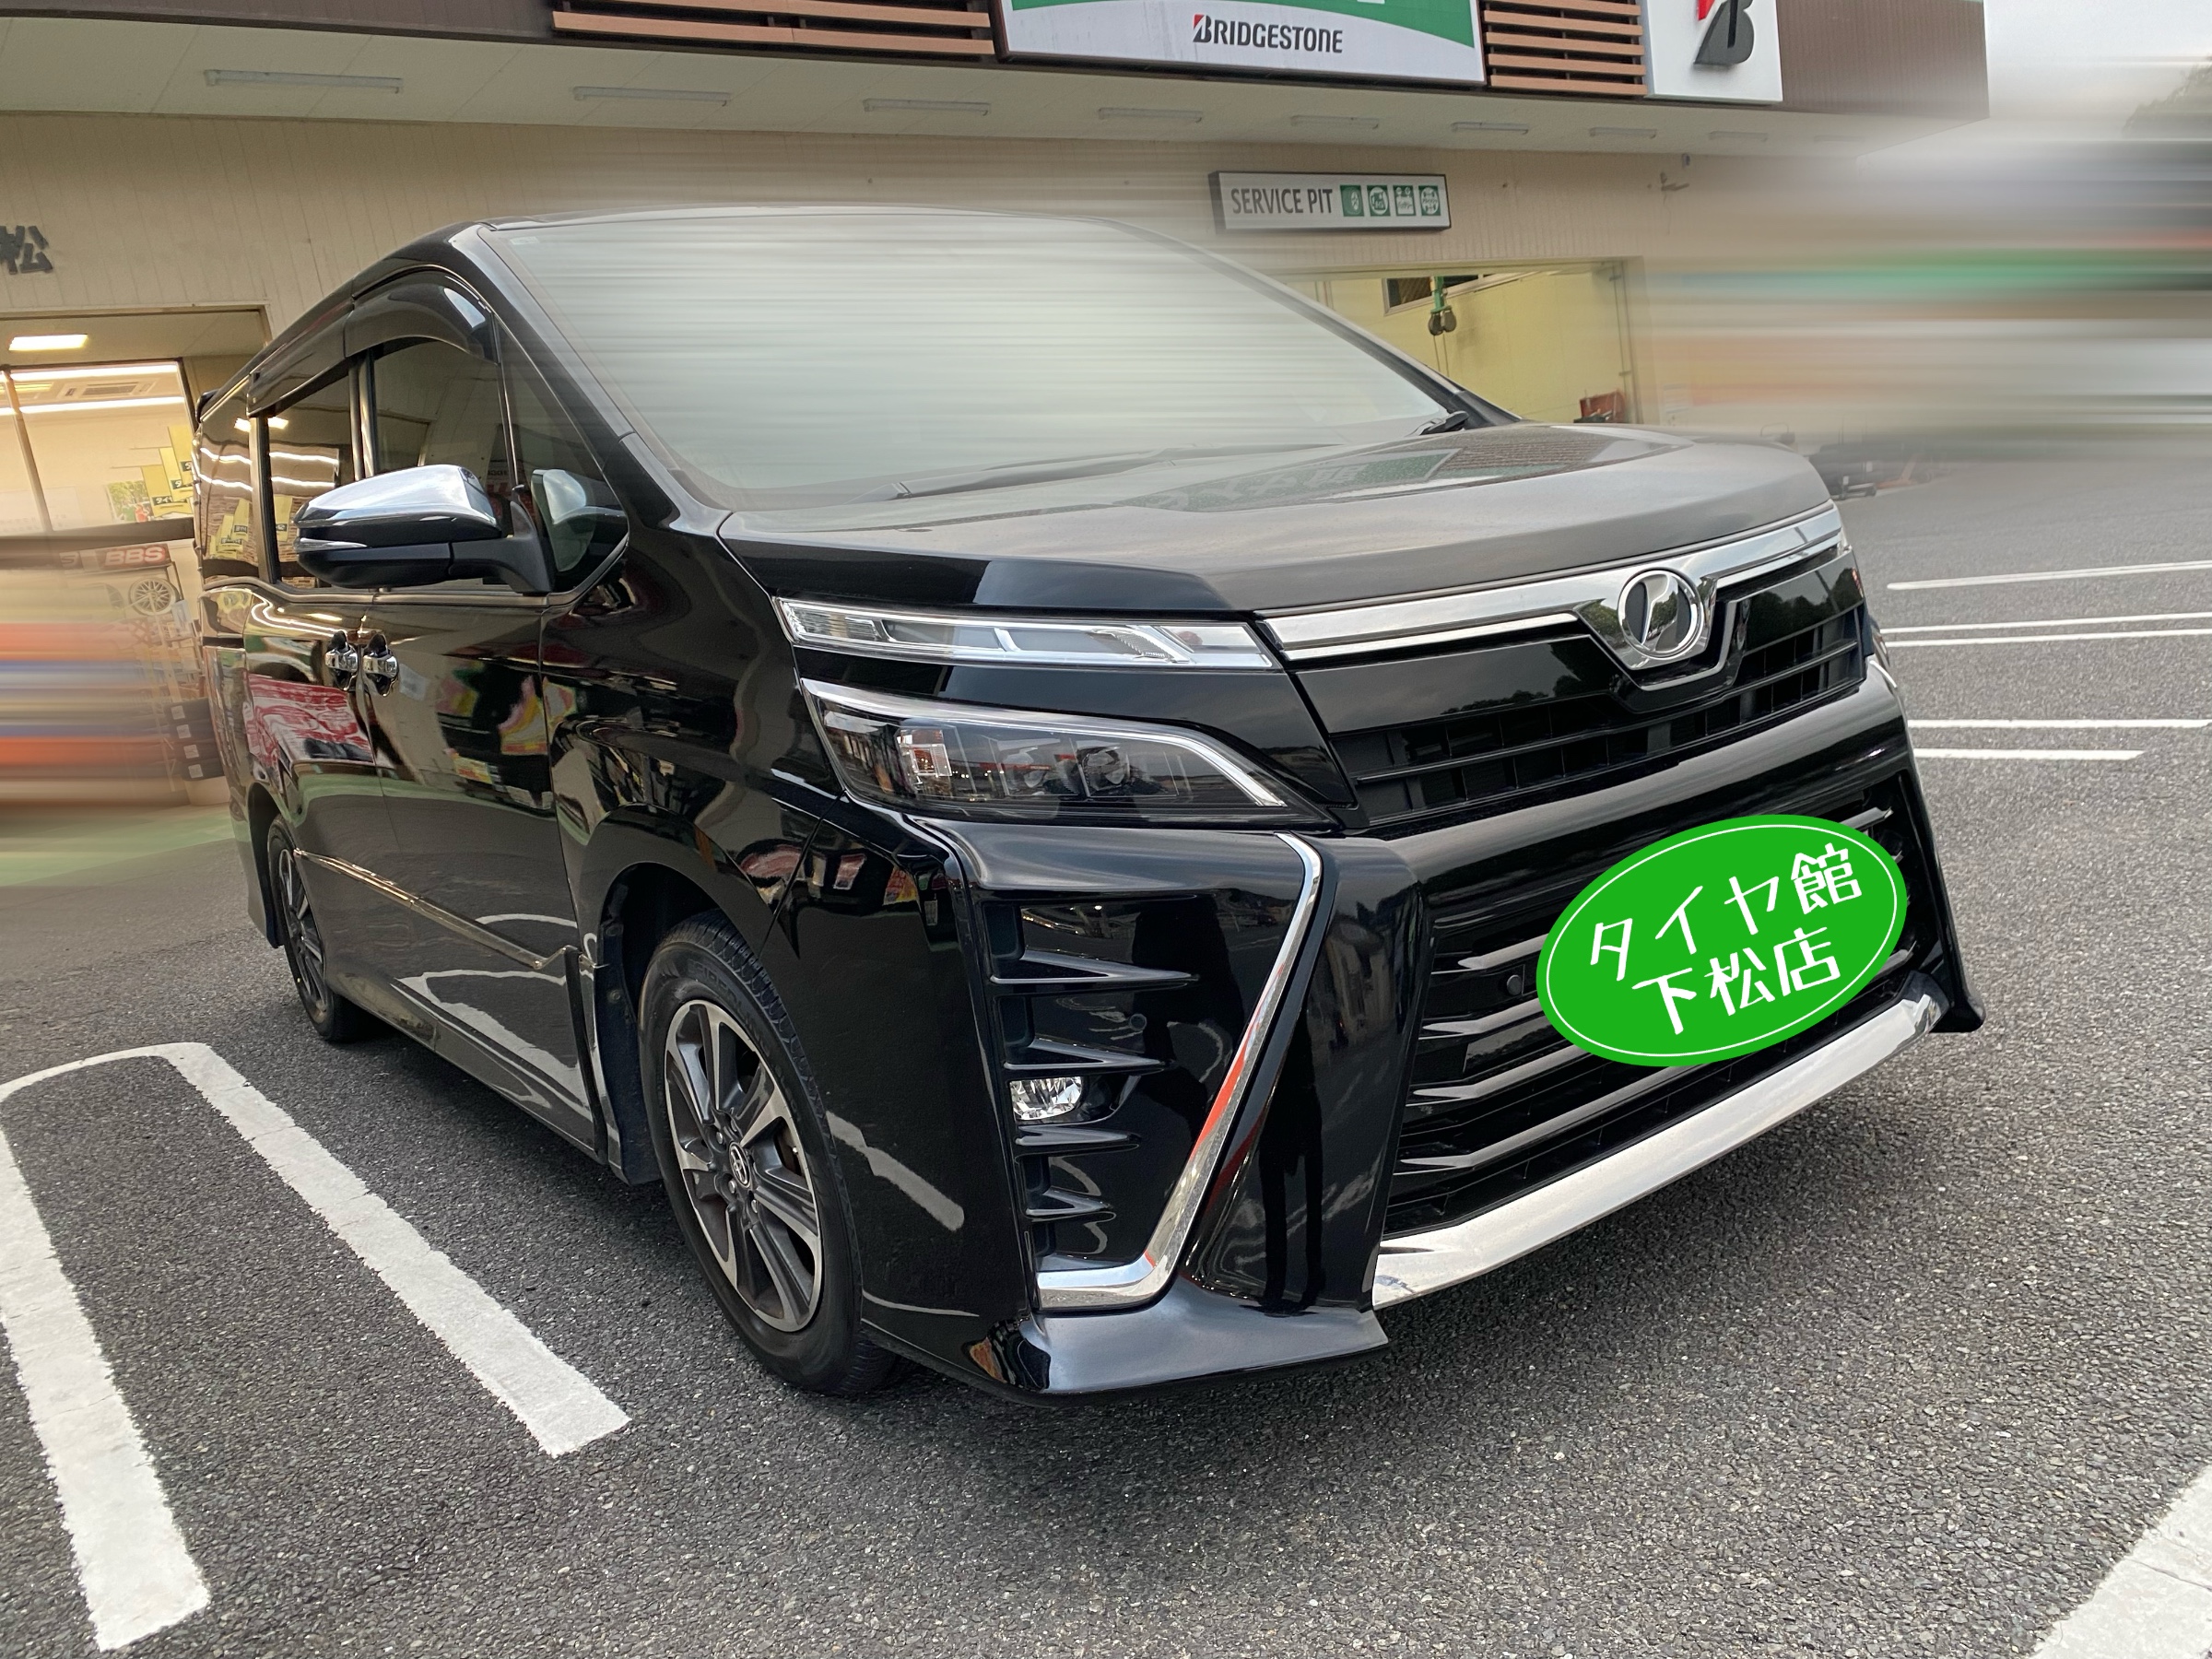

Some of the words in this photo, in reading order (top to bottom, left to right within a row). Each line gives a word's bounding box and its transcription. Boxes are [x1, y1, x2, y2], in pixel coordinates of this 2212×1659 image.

[1193, 14, 1343, 53] BRIDGESTONE
[1230, 188, 1304, 214] SERVICE
[1307, 188, 1333, 214] PIT
[104, 546, 166, 566] BBS
